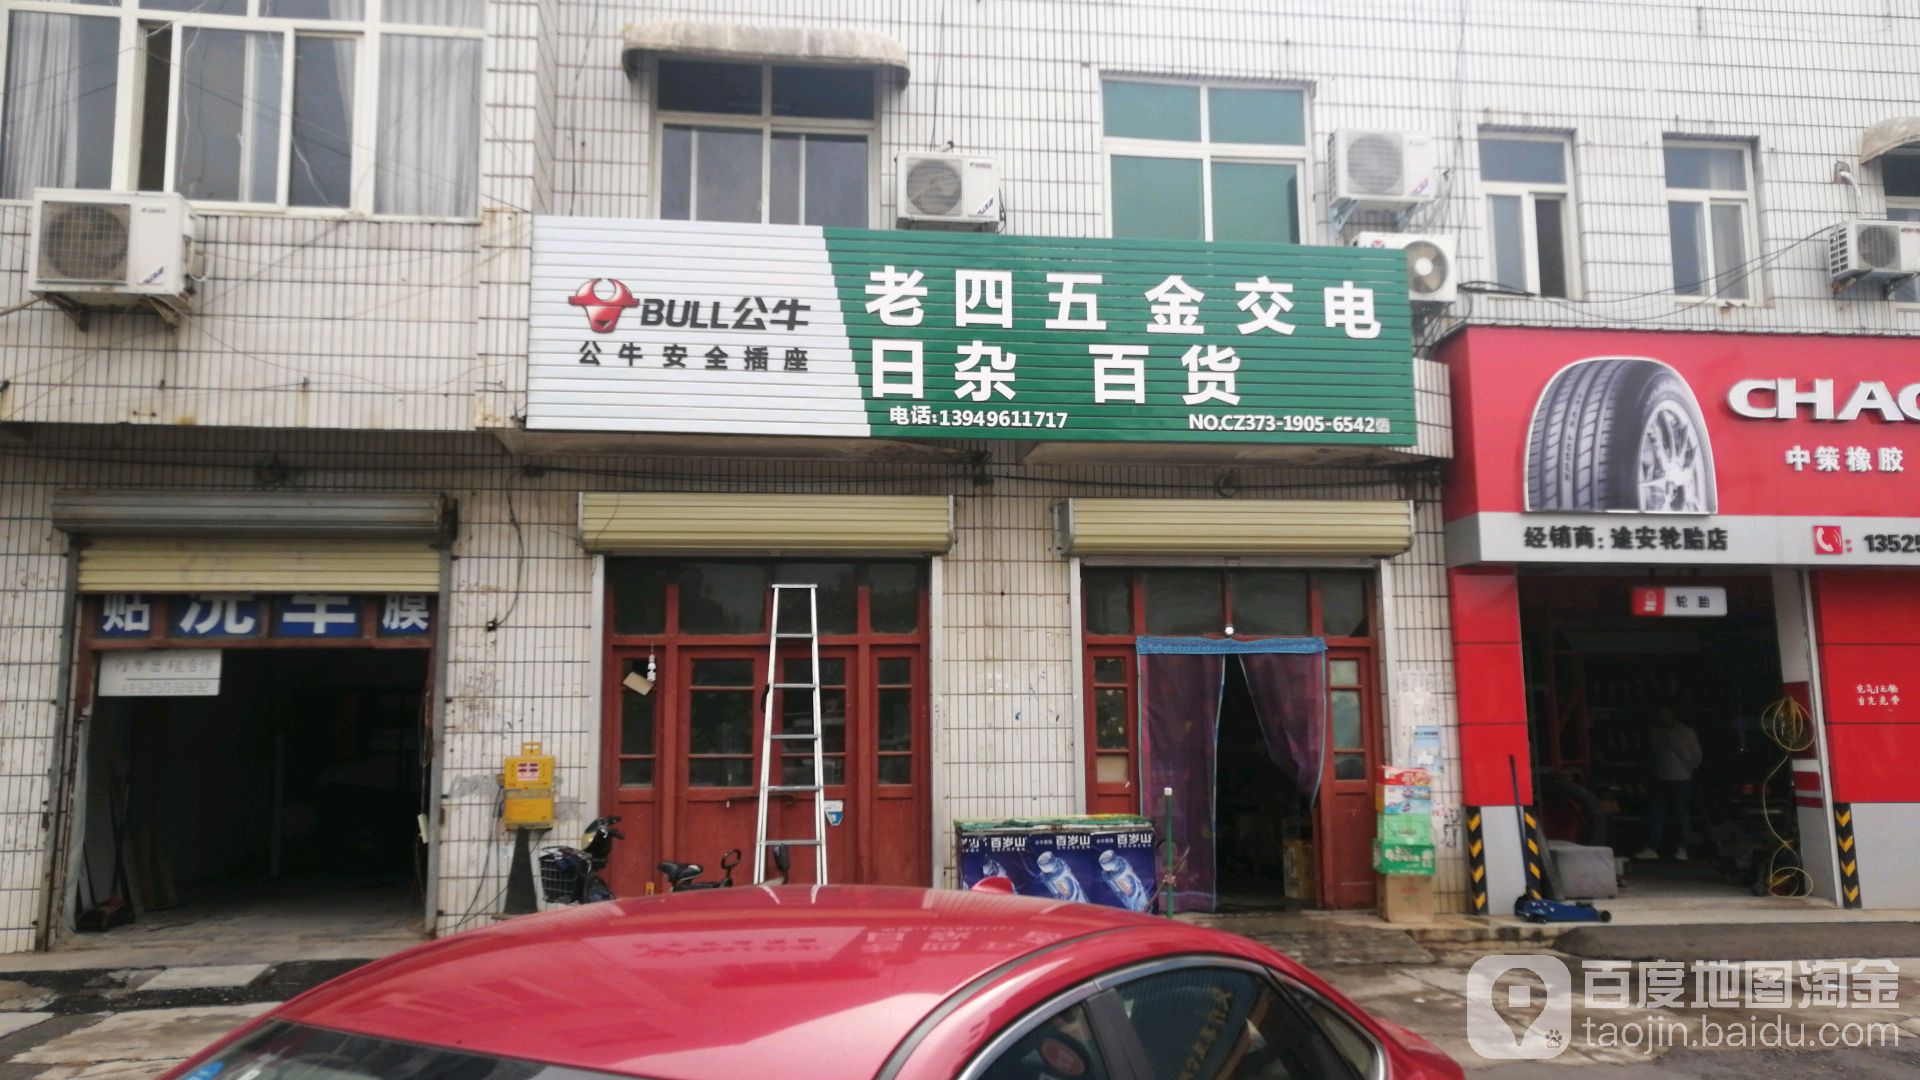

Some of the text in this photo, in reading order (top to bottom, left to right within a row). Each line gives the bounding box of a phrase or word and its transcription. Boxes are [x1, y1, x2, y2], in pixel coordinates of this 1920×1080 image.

[865, 265, 1382, 339] 老四五金交电
[578, 341, 809, 371] 公牛安全插座
[889, 405, 1068, 428] 电话:13949611717
[1188, 413, 1376, 433] NO.CZ373-1905-6542
[1785, 445, 1905, 473] 中策橡胶
[990, 836, 1026, 848] 百岁山
[1056, 834, 1090, 846] 百岁山
[1117, 832, 1152, 844] 百岁山
